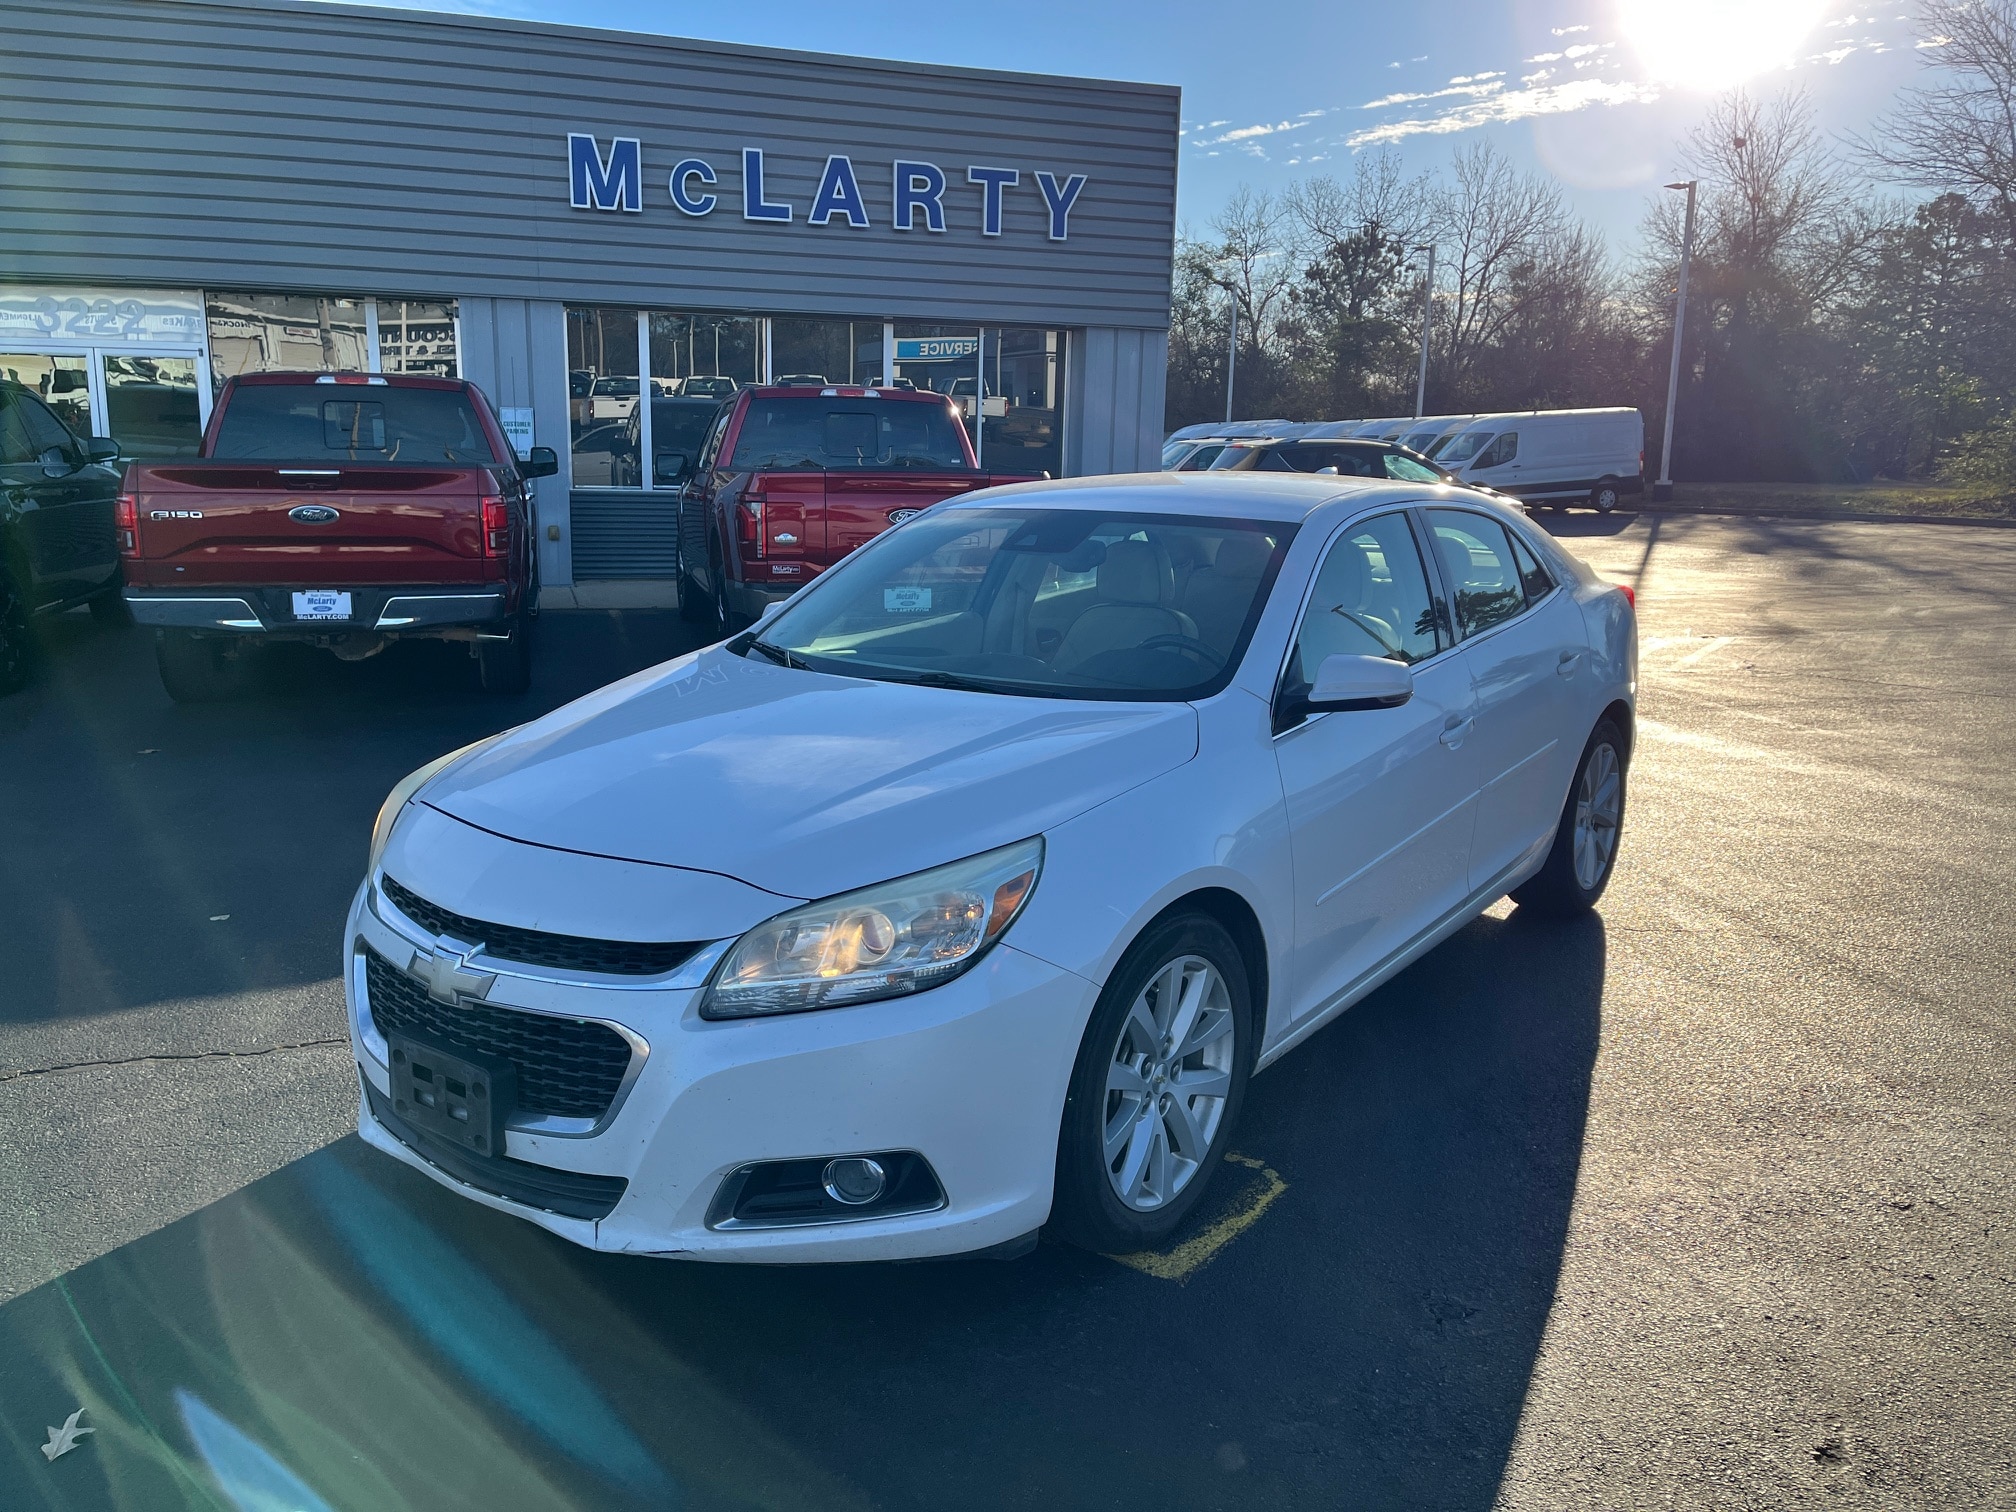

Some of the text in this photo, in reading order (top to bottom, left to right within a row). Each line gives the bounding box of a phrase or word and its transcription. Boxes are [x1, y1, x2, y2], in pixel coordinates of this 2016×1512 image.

[35, 296, 147, 334] 3222
[300, 508, 328, 520] Ford
[307, 597, 337, 605] McLarty
